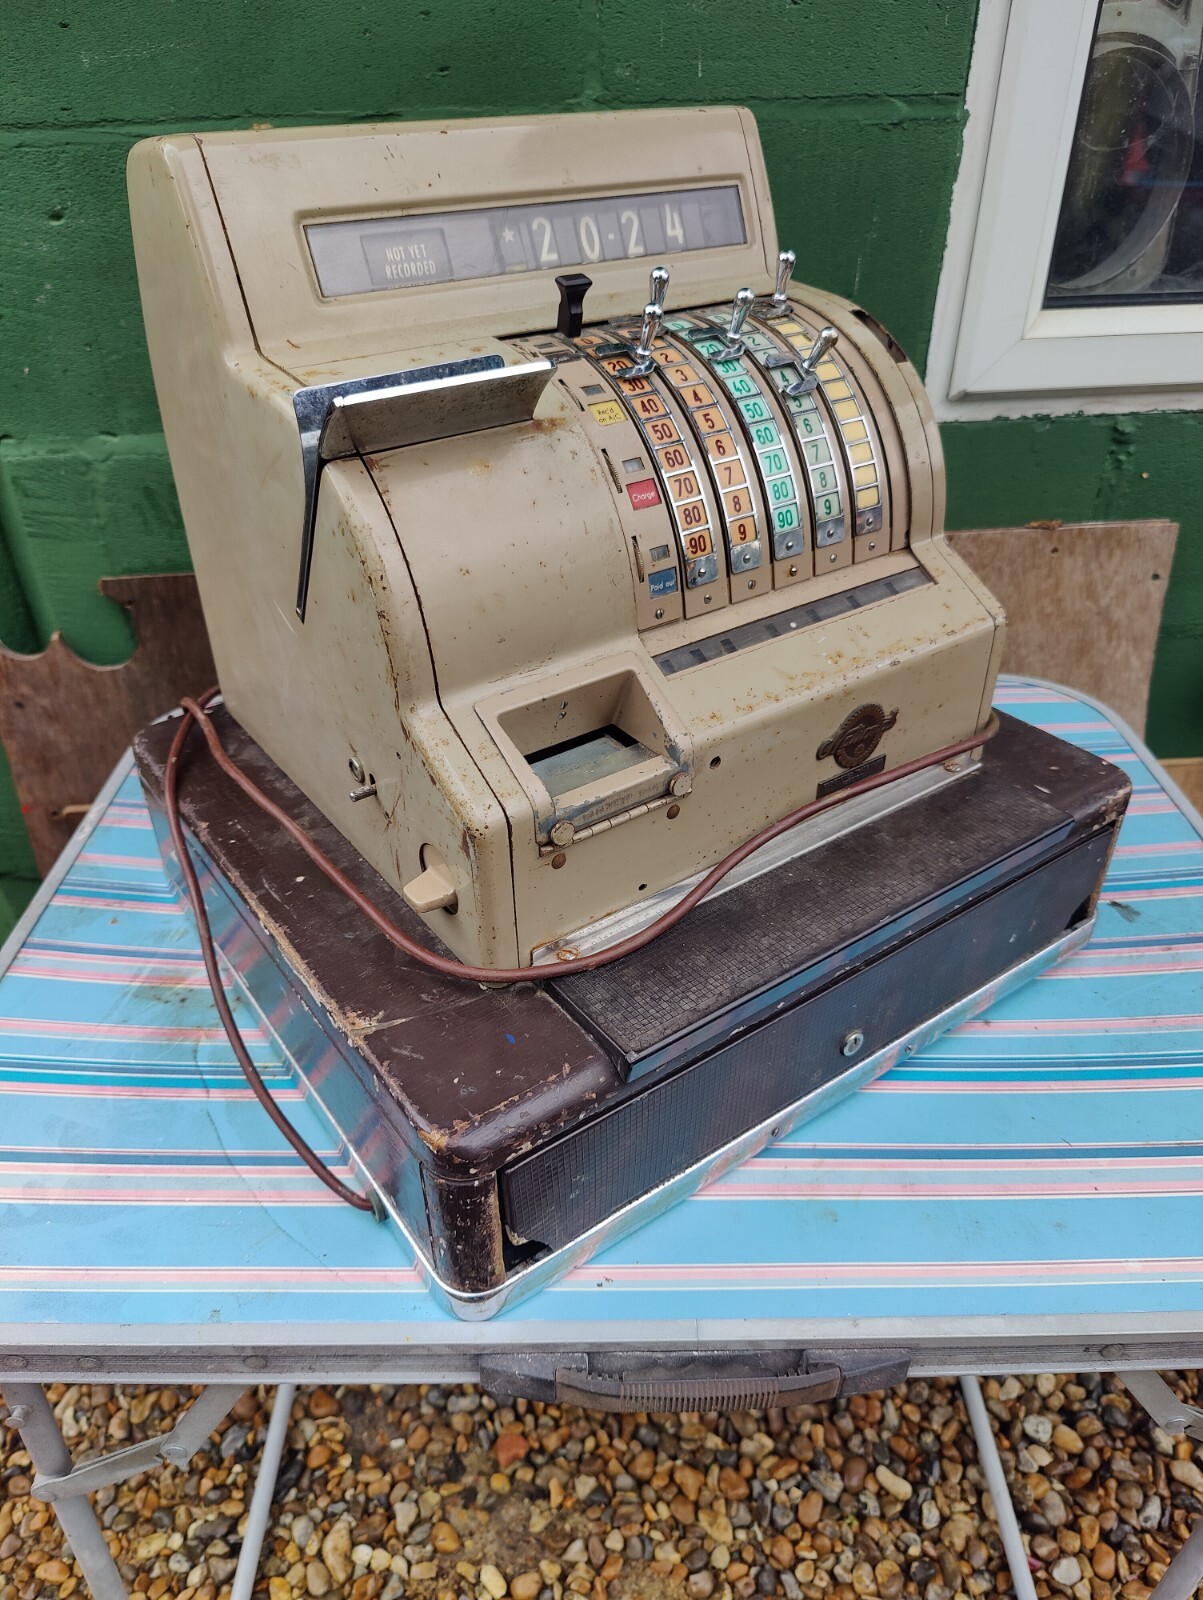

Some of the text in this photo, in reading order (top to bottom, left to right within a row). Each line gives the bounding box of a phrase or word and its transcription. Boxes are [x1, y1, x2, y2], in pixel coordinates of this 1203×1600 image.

[385, 244, 427, 262] NOT YET
[385, 260, 436, 280] RECORDED
[747, 336, 761, 346] 2
[660, 352, 674, 363] 2
[675, 369, 688, 382] 3
[717, 360, 737, 374] 30
[623, 377, 645, 392] 30
[780, 370, 790, 385] 4
[732, 379, 751, 395] 40
[692, 389, 703, 404] 4
[640, 398, 660, 415] 40
[744, 402, 764, 420] 50
[702, 412, 715, 430] 5
[803, 418, 813, 434] 6
[652, 422, 673, 441] 50
[756, 426, 774, 446] 60
[714, 439, 726, 456] 6
[811, 444, 819, 462] 7
[664, 449, 685, 468] 60
[765, 454, 782, 473] 70
[724, 466, 732, 486] 7
[819, 471, 828, 489] 8
[674, 477, 694, 498] 70
[772, 481, 789, 501] 80
[632, 492, 656, 502] Charge
[733, 495, 742, 513] 8
[683, 505, 702, 526] 80
[824, 498, 832, 516] 9
[777, 509, 793, 529] 90
[738, 523, 747, 542] 9
[689, 534, 707, 555] 90
[650, 581, 664, 592] Paid
